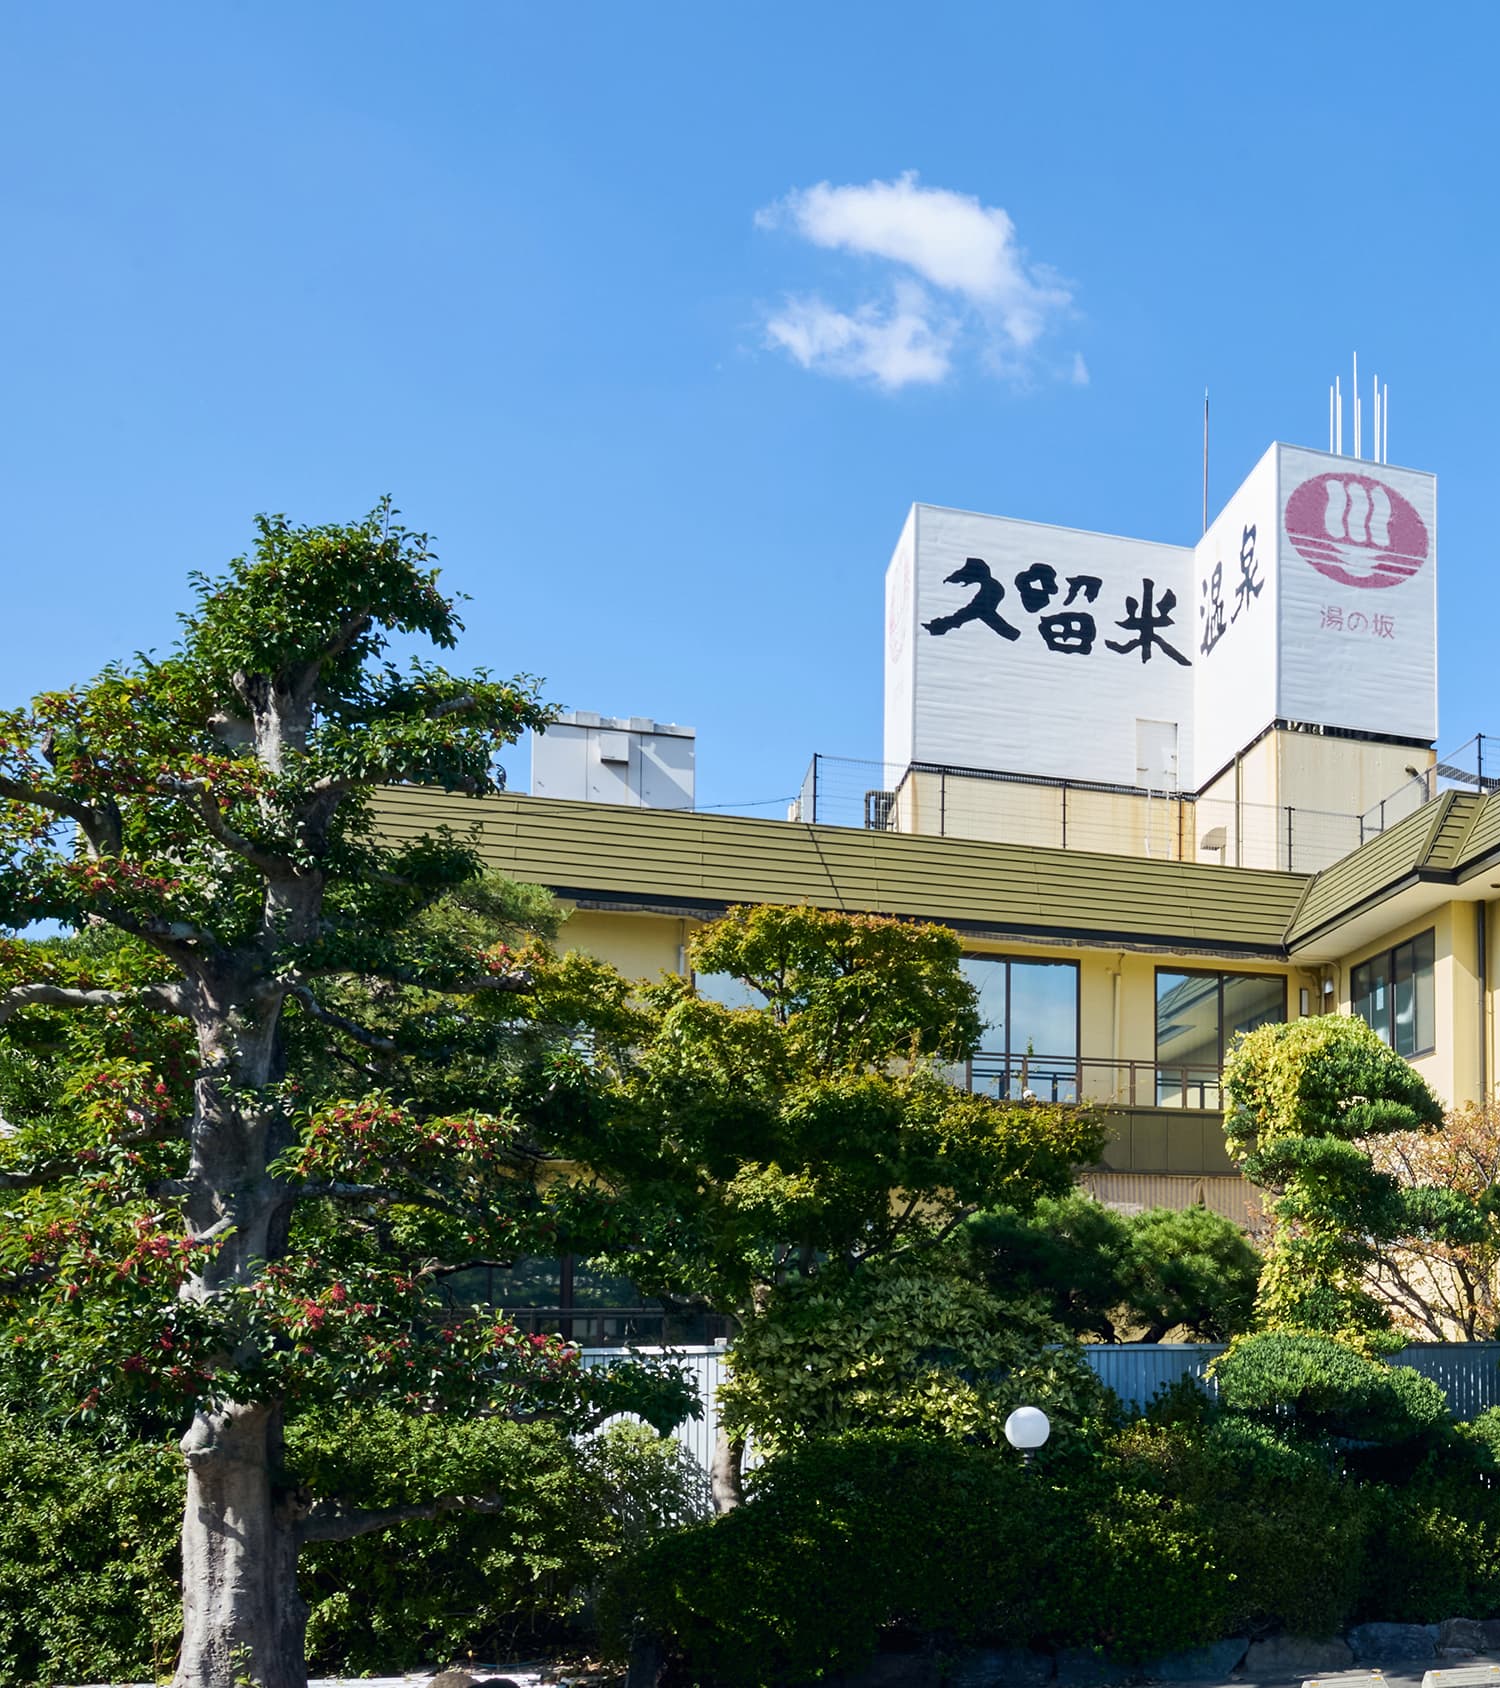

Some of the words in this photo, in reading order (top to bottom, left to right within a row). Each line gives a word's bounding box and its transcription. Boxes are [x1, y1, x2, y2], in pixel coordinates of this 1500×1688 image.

[921, 558, 1193, 666] 久留米
[1200, 524, 1264, 656] 温泉
[1320, 605, 1395, 640] 湯の坂
